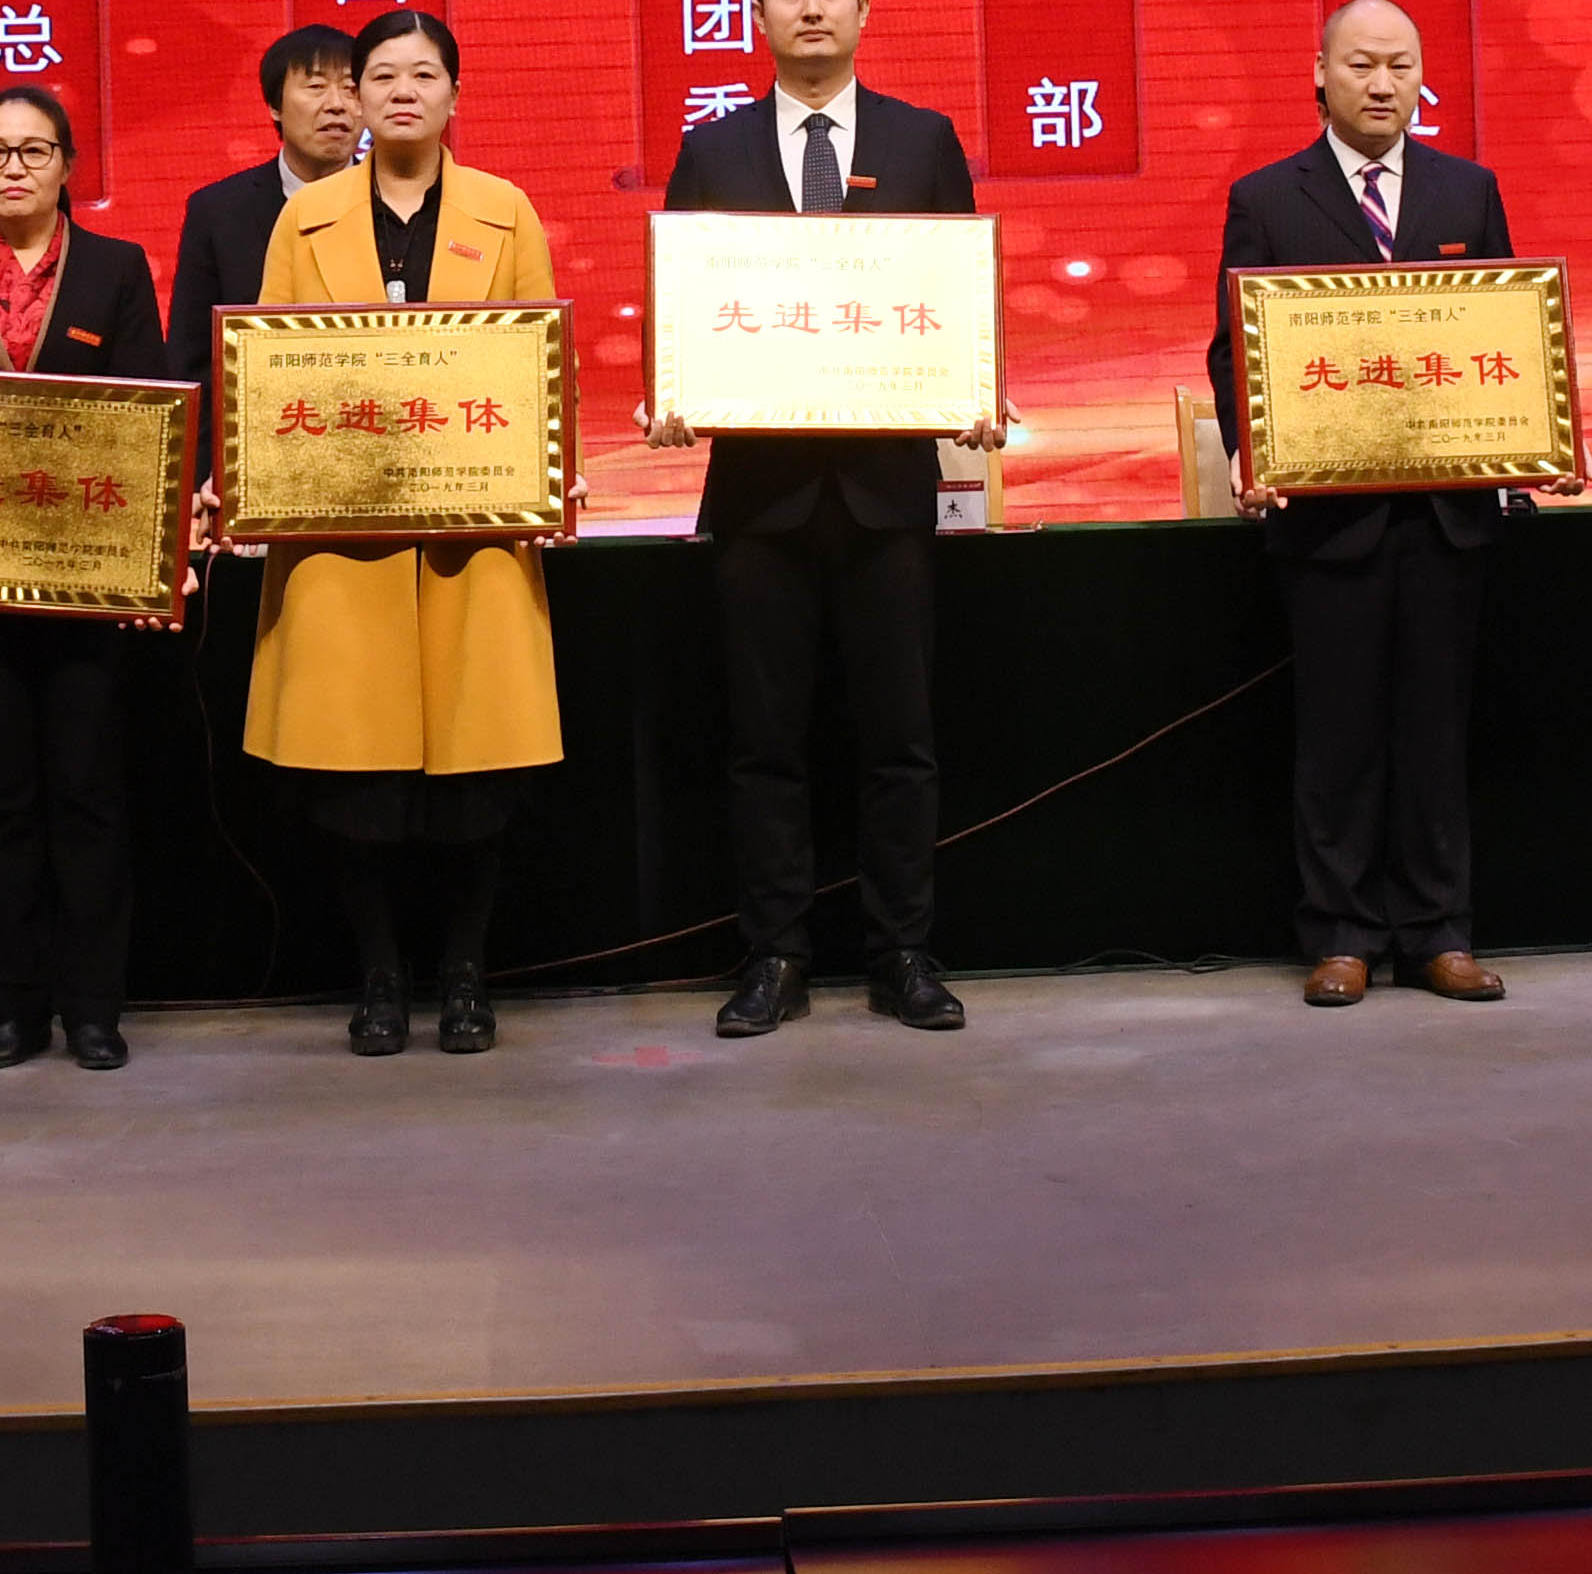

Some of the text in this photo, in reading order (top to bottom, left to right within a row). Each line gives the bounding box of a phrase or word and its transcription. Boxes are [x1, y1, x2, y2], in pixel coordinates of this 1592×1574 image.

[712, 300, 943, 336] 先进集体
[1289, 307, 1466, 327] 南阳师范学院“三全育人”
[269, 350, 458, 369] 南阳师范学院“三全育人”
[1299, 351, 1520, 391] 先进集体
[275, 396, 509, 436] 先进集体
